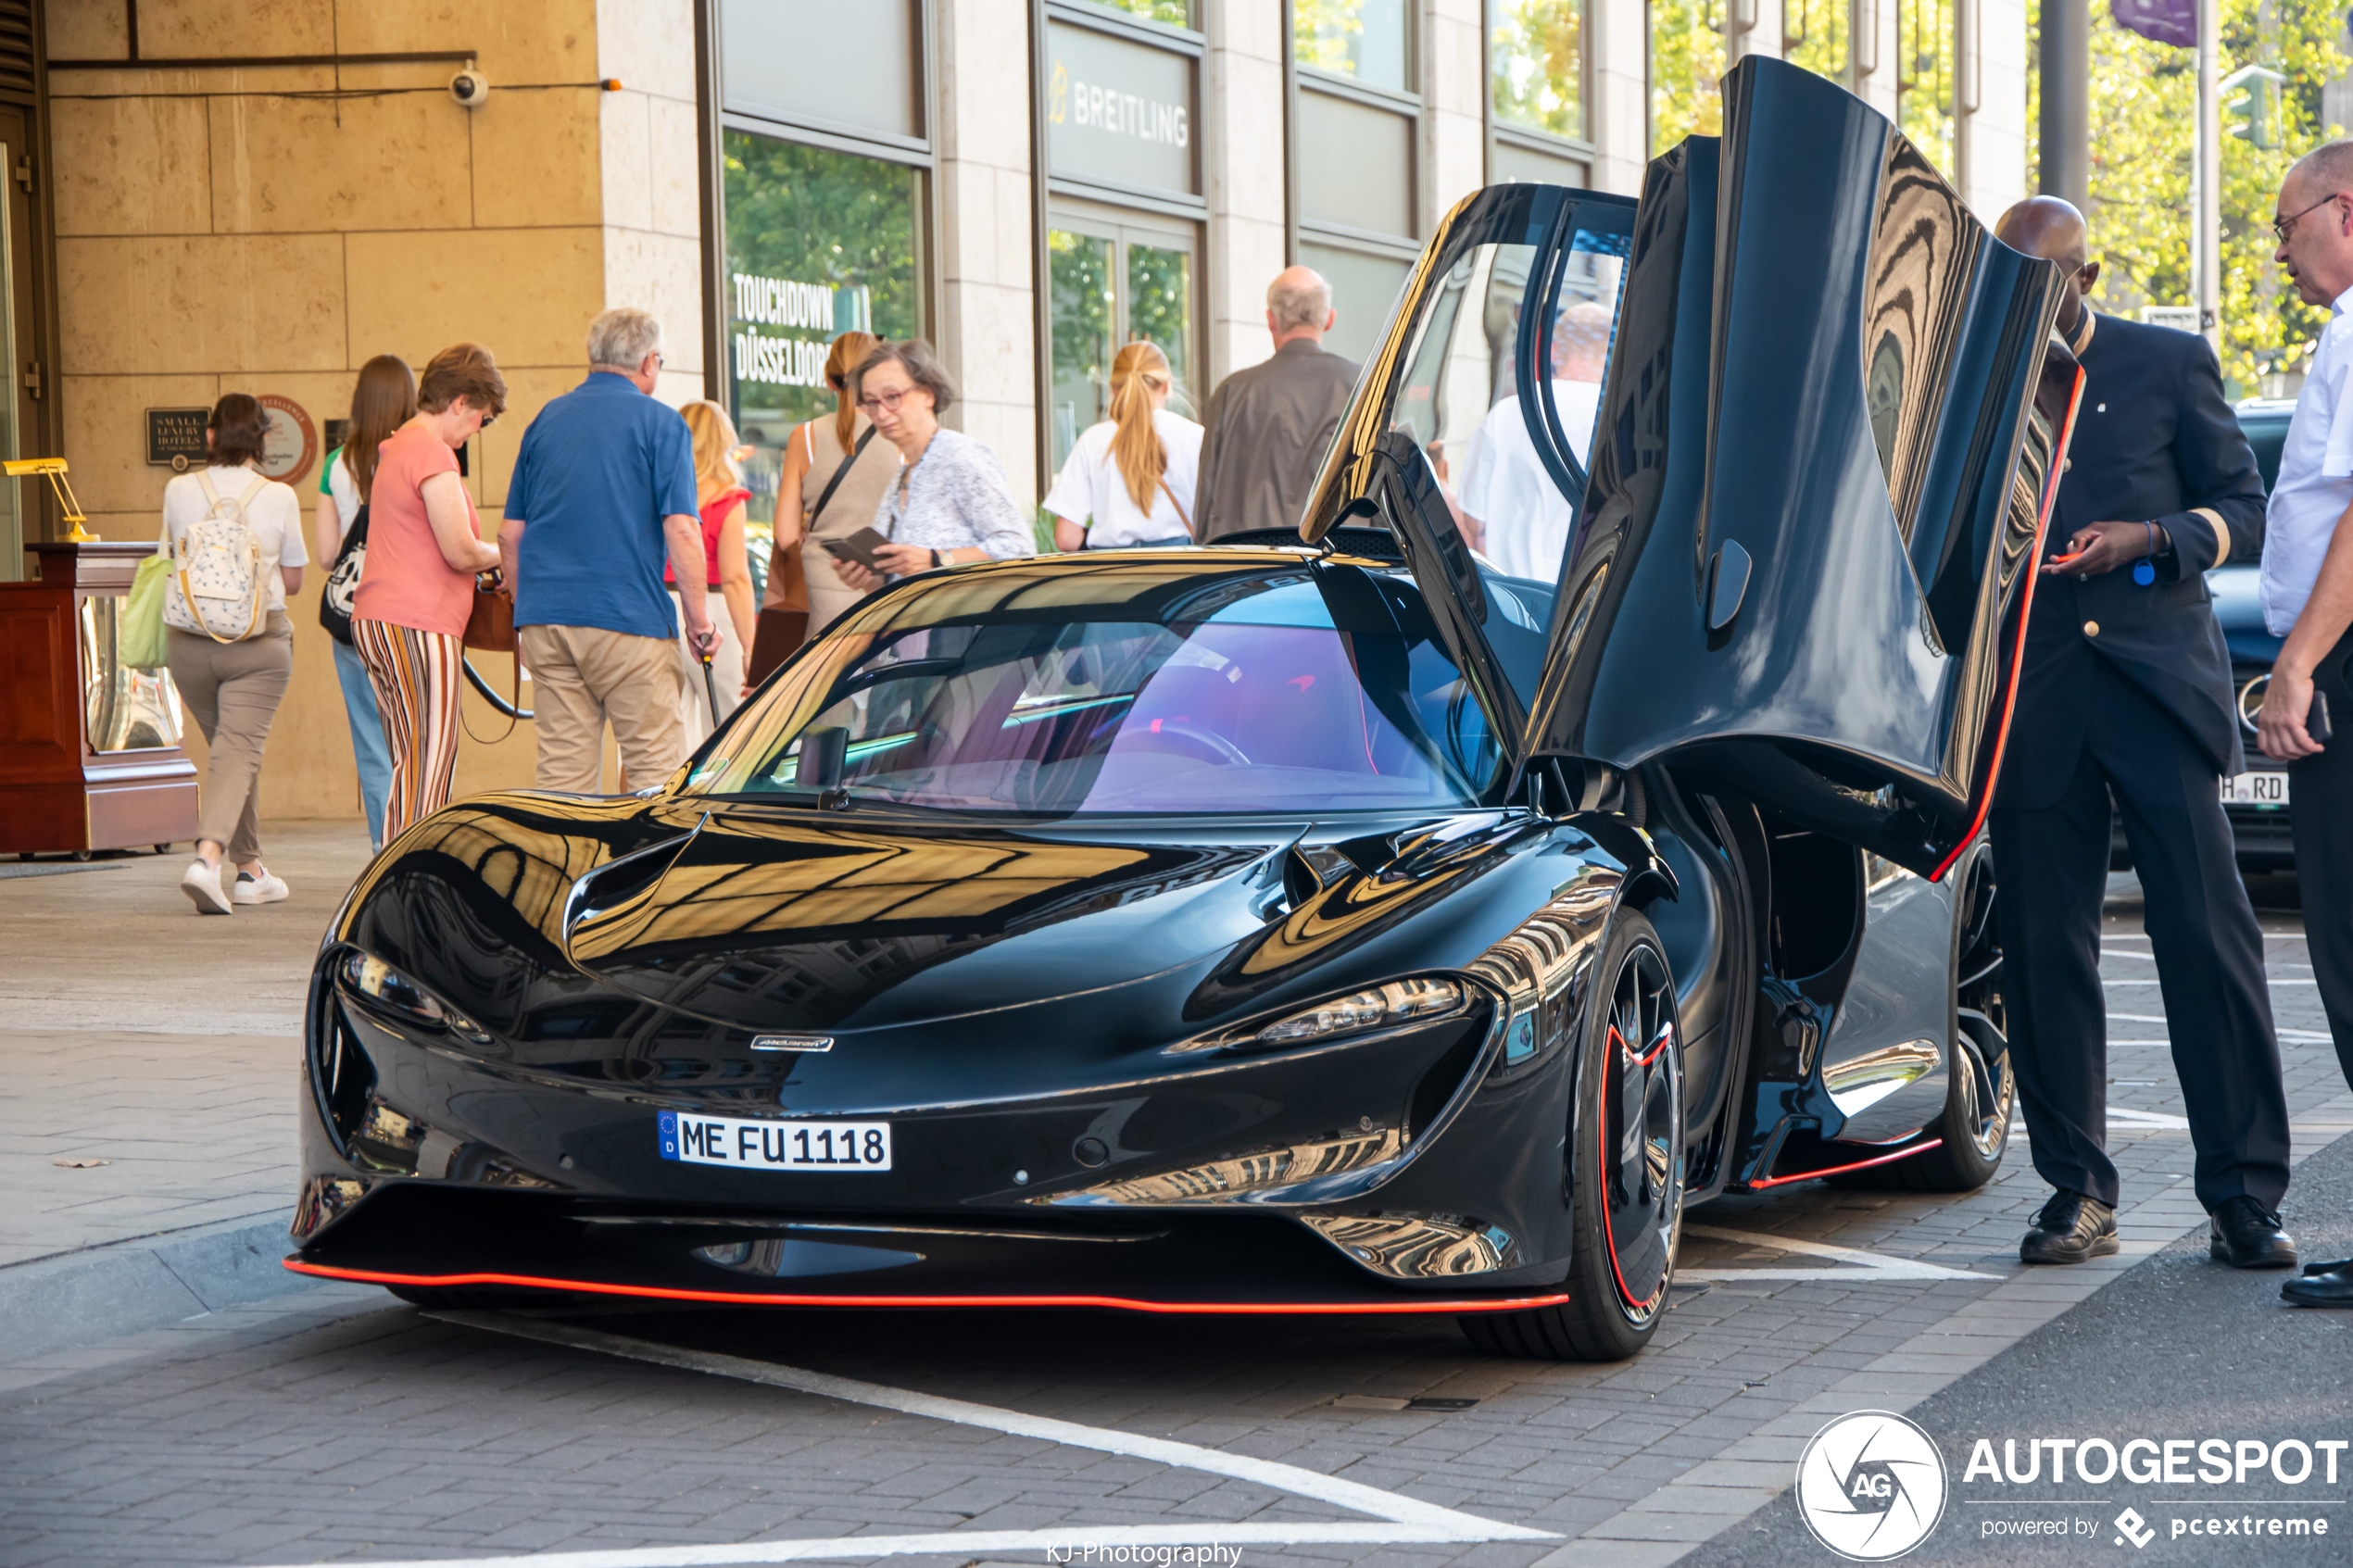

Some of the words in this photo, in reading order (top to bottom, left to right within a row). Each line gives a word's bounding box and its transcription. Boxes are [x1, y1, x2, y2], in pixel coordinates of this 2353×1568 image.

[1074, 81, 1189, 148] BREITLING
[733, 272, 834, 332] TOUCHDOWN
[157, 417, 200, 426] SMALL
[157, 427, 198, 435] LUXURY
[157, 436, 200, 445] HOTELS
[2254, 777, 2282, 799] RD
[665, 1140, 674, 1153] D
[682, 1120, 727, 1160] ME
[738, 1125, 786, 1163] FU
[793, 1129, 886, 1164] 1118
